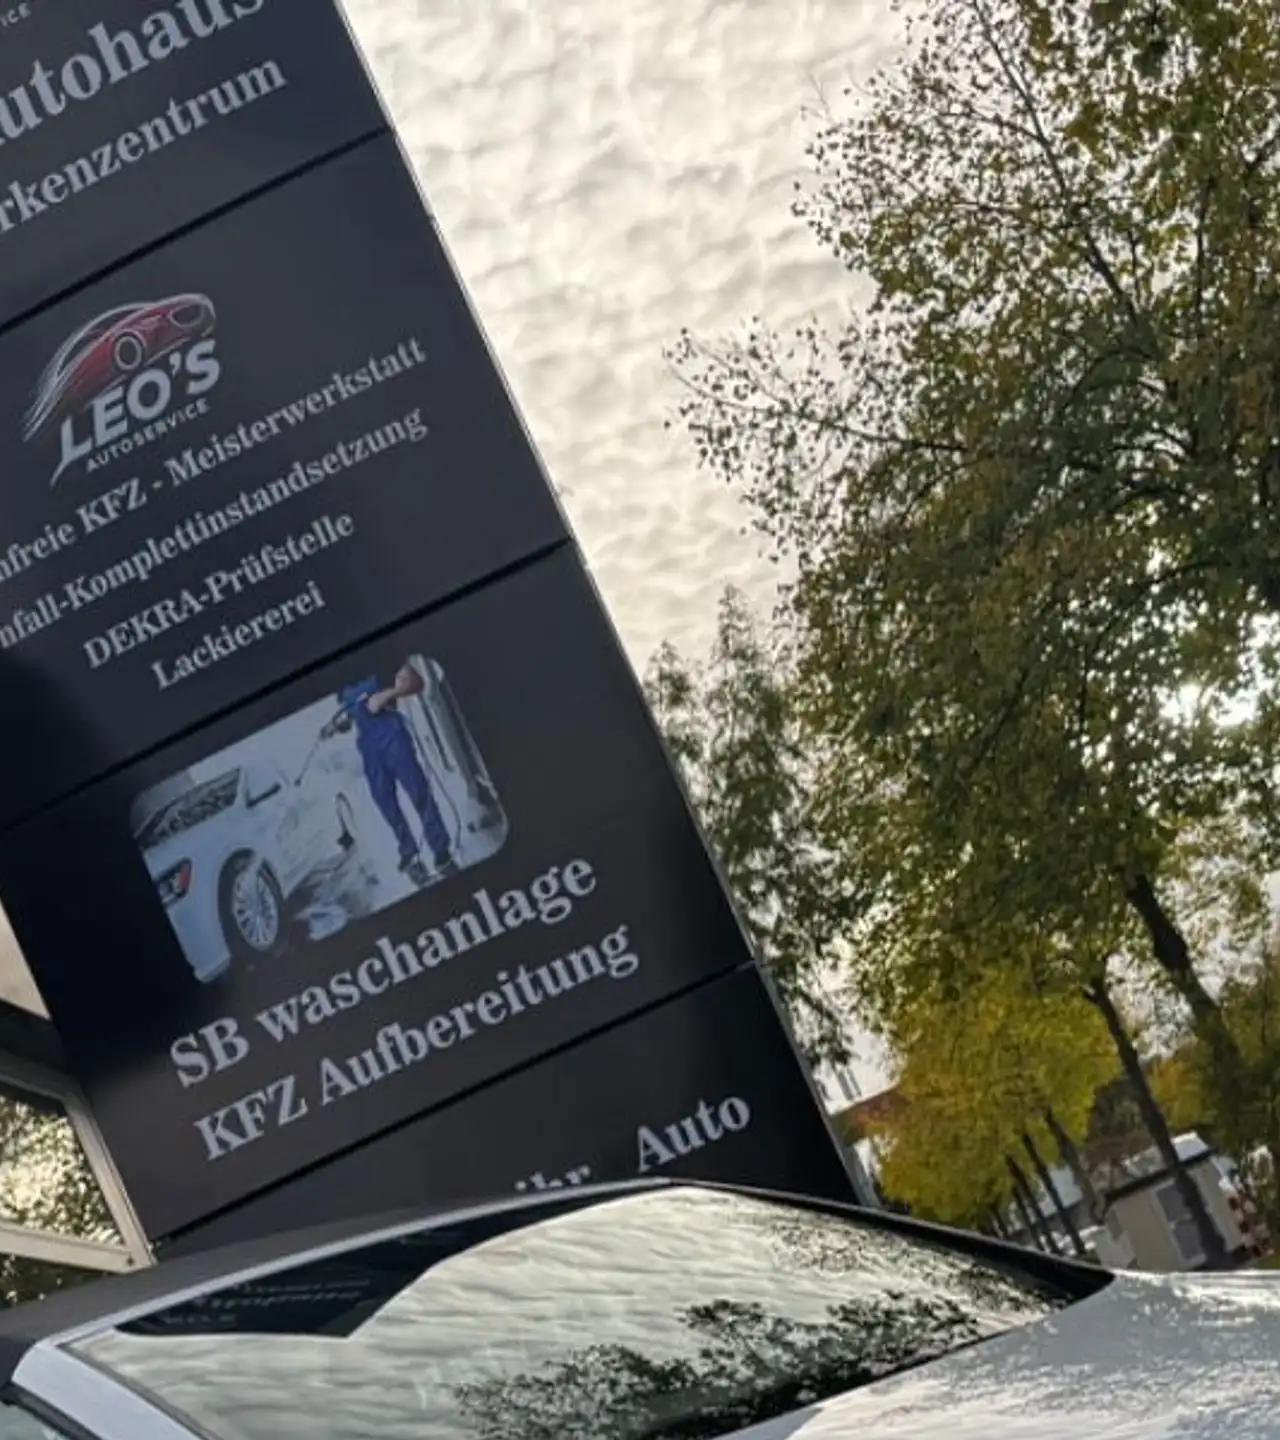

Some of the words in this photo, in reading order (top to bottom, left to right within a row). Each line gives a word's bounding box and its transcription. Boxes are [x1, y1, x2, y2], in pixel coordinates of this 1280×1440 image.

[50, 338, 220, 486] LEO'S
[76, 477, 148, 534] KFZ
[165, 336, 426, 486] Meisterwerkstatt
[86, 399, 210, 473] AUTOSERVICE
[83, 512, 354, 669] DEKRA-Prüfstelle
[151, 580, 325, 690] Lackiererei
[170, 1017, 249, 1088] SB
[256, 858, 596, 1043] waschanlage
[194, 1074, 309, 1161] KFZ
[321, 924, 639, 1106] Aufbereitung
[637, 1096, 750, 1172] Auto
